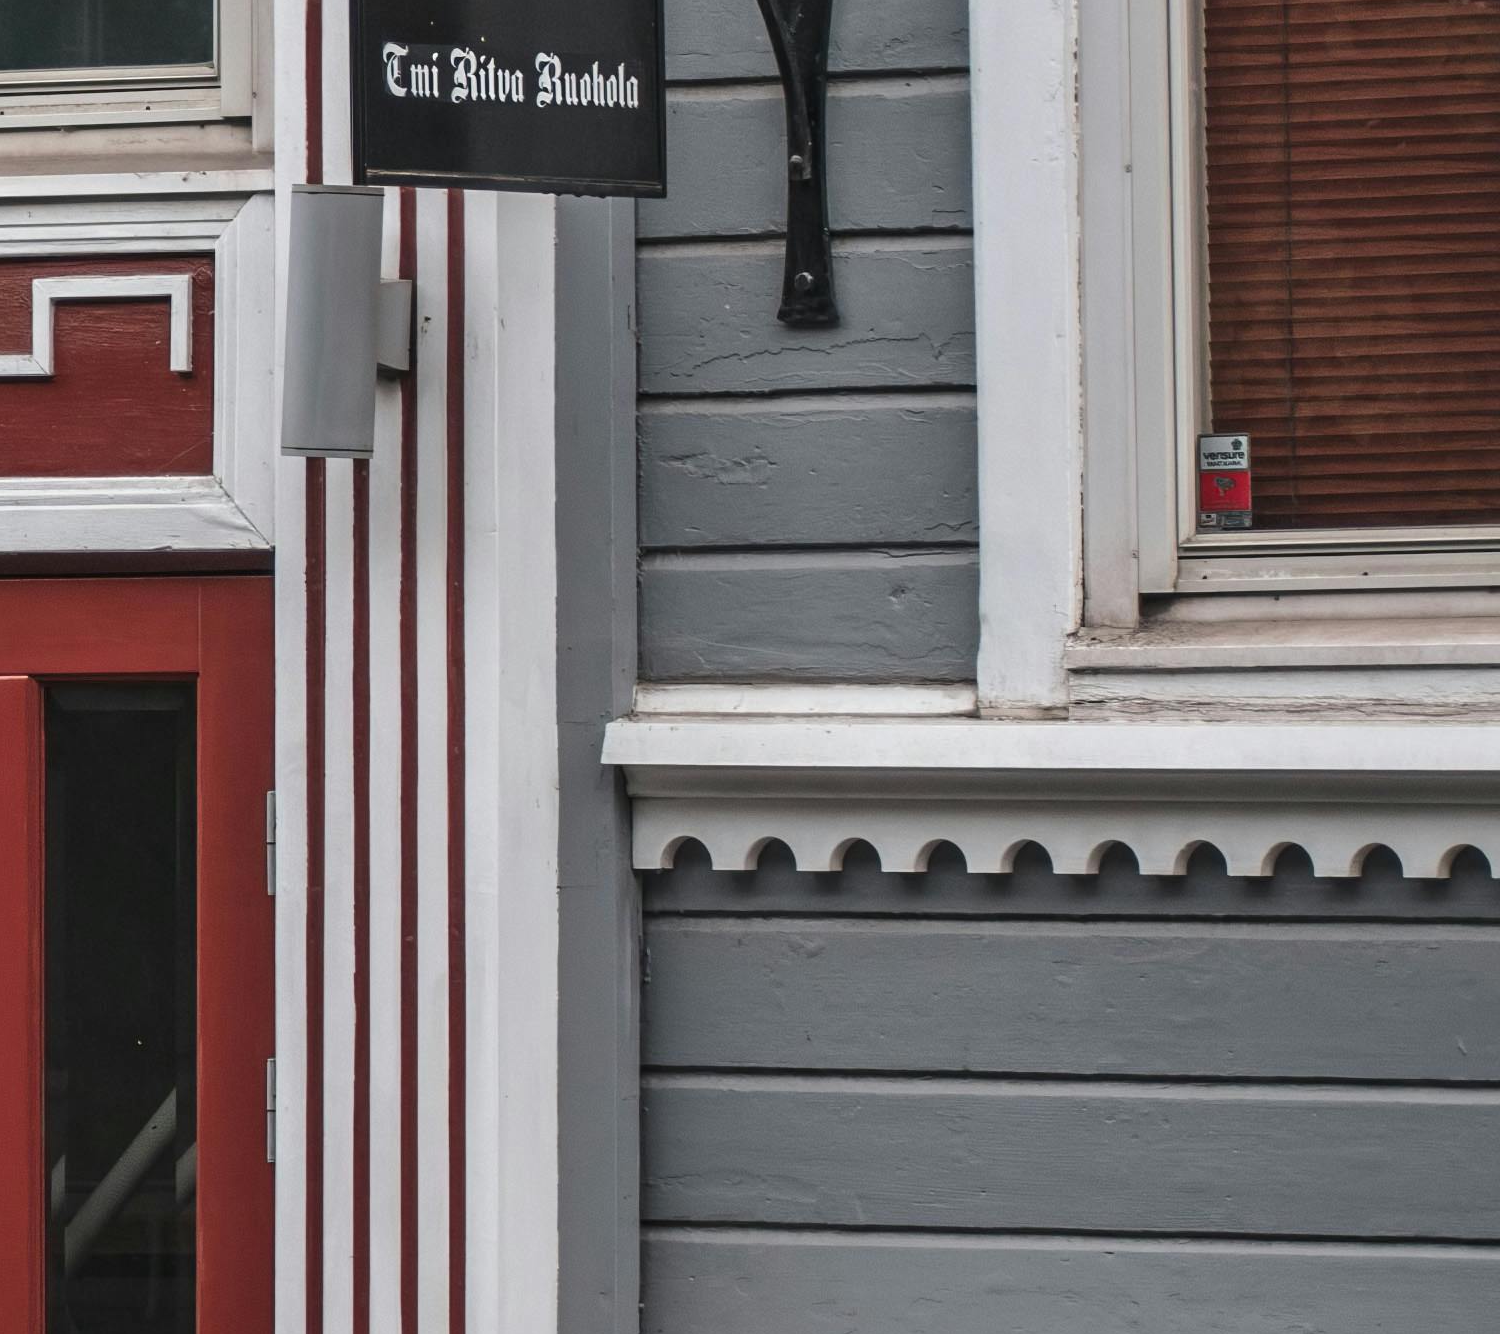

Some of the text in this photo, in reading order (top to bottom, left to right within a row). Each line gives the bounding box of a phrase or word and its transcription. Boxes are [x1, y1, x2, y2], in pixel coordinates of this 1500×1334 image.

[382, 41, 639, 109] Tmi Ritva Ruohola
